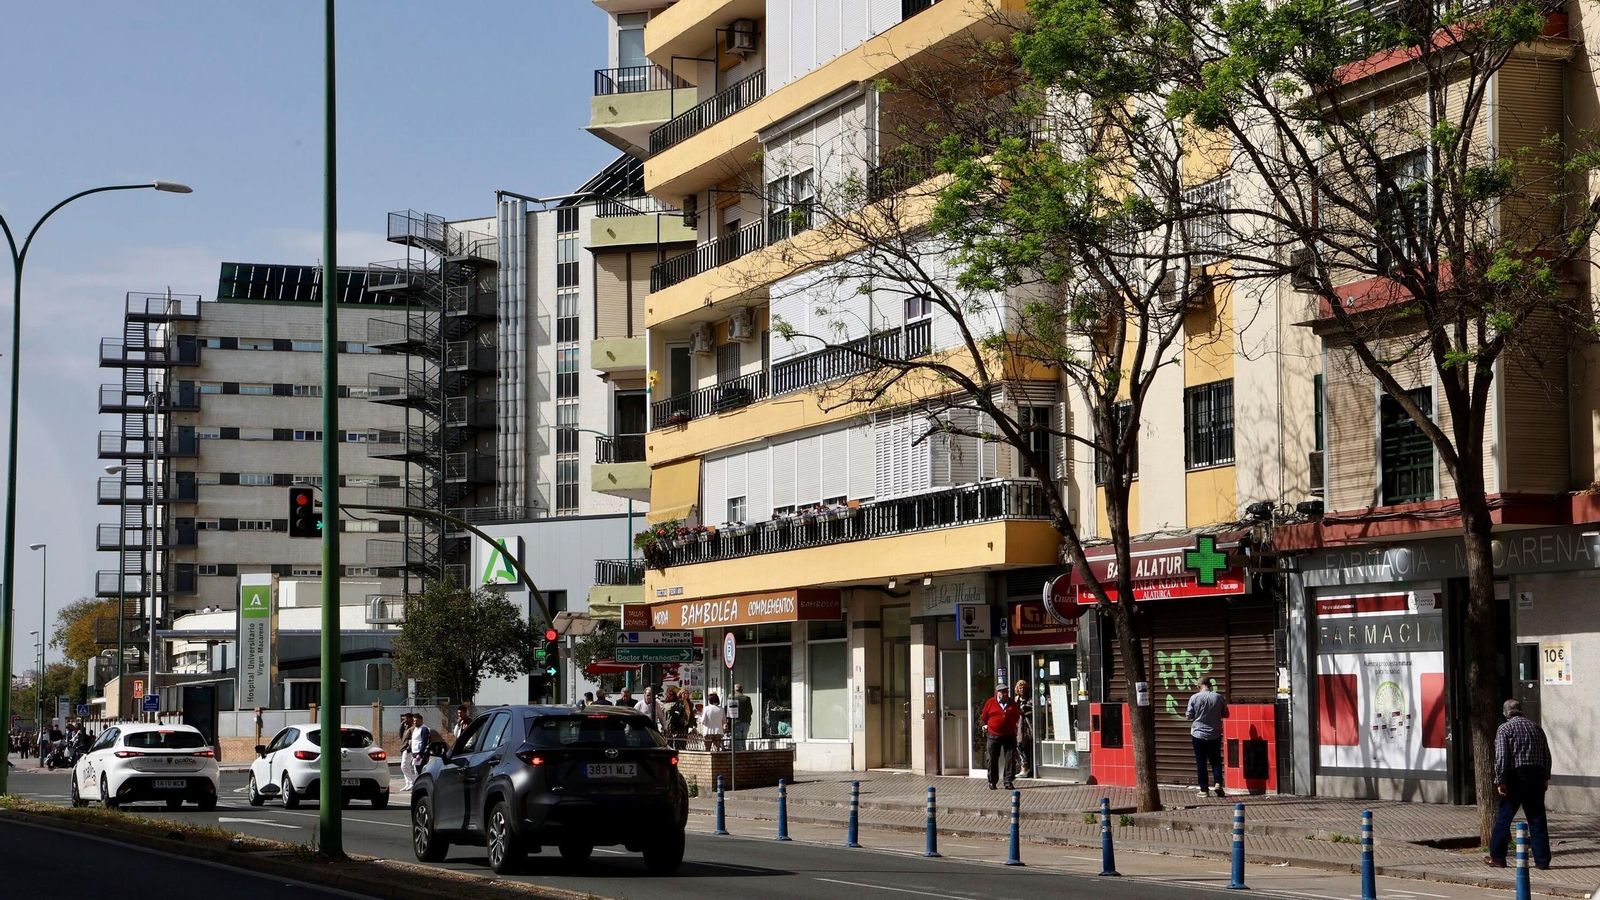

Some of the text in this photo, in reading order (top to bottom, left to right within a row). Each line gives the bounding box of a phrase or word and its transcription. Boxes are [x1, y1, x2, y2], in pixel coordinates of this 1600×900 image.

[1135, 556, 1182, 577] ALATUR
[1324, 543, 1431, 578] FARMACIA
[1454, 534, 1590, 571] MCARENA
[1142, 590, 1171, 599] ALATURCA
[653, 596, 795, 626] MODA BAMBOLEA COMPLEMENTOS
[1320, 622, 1439, 645] FARMACIA
[247, 622, 255, 703] Hospital Universitario
[257, 655, 265, 677] Virgen
[588, 764, 635, 775] 3831 MLZ
